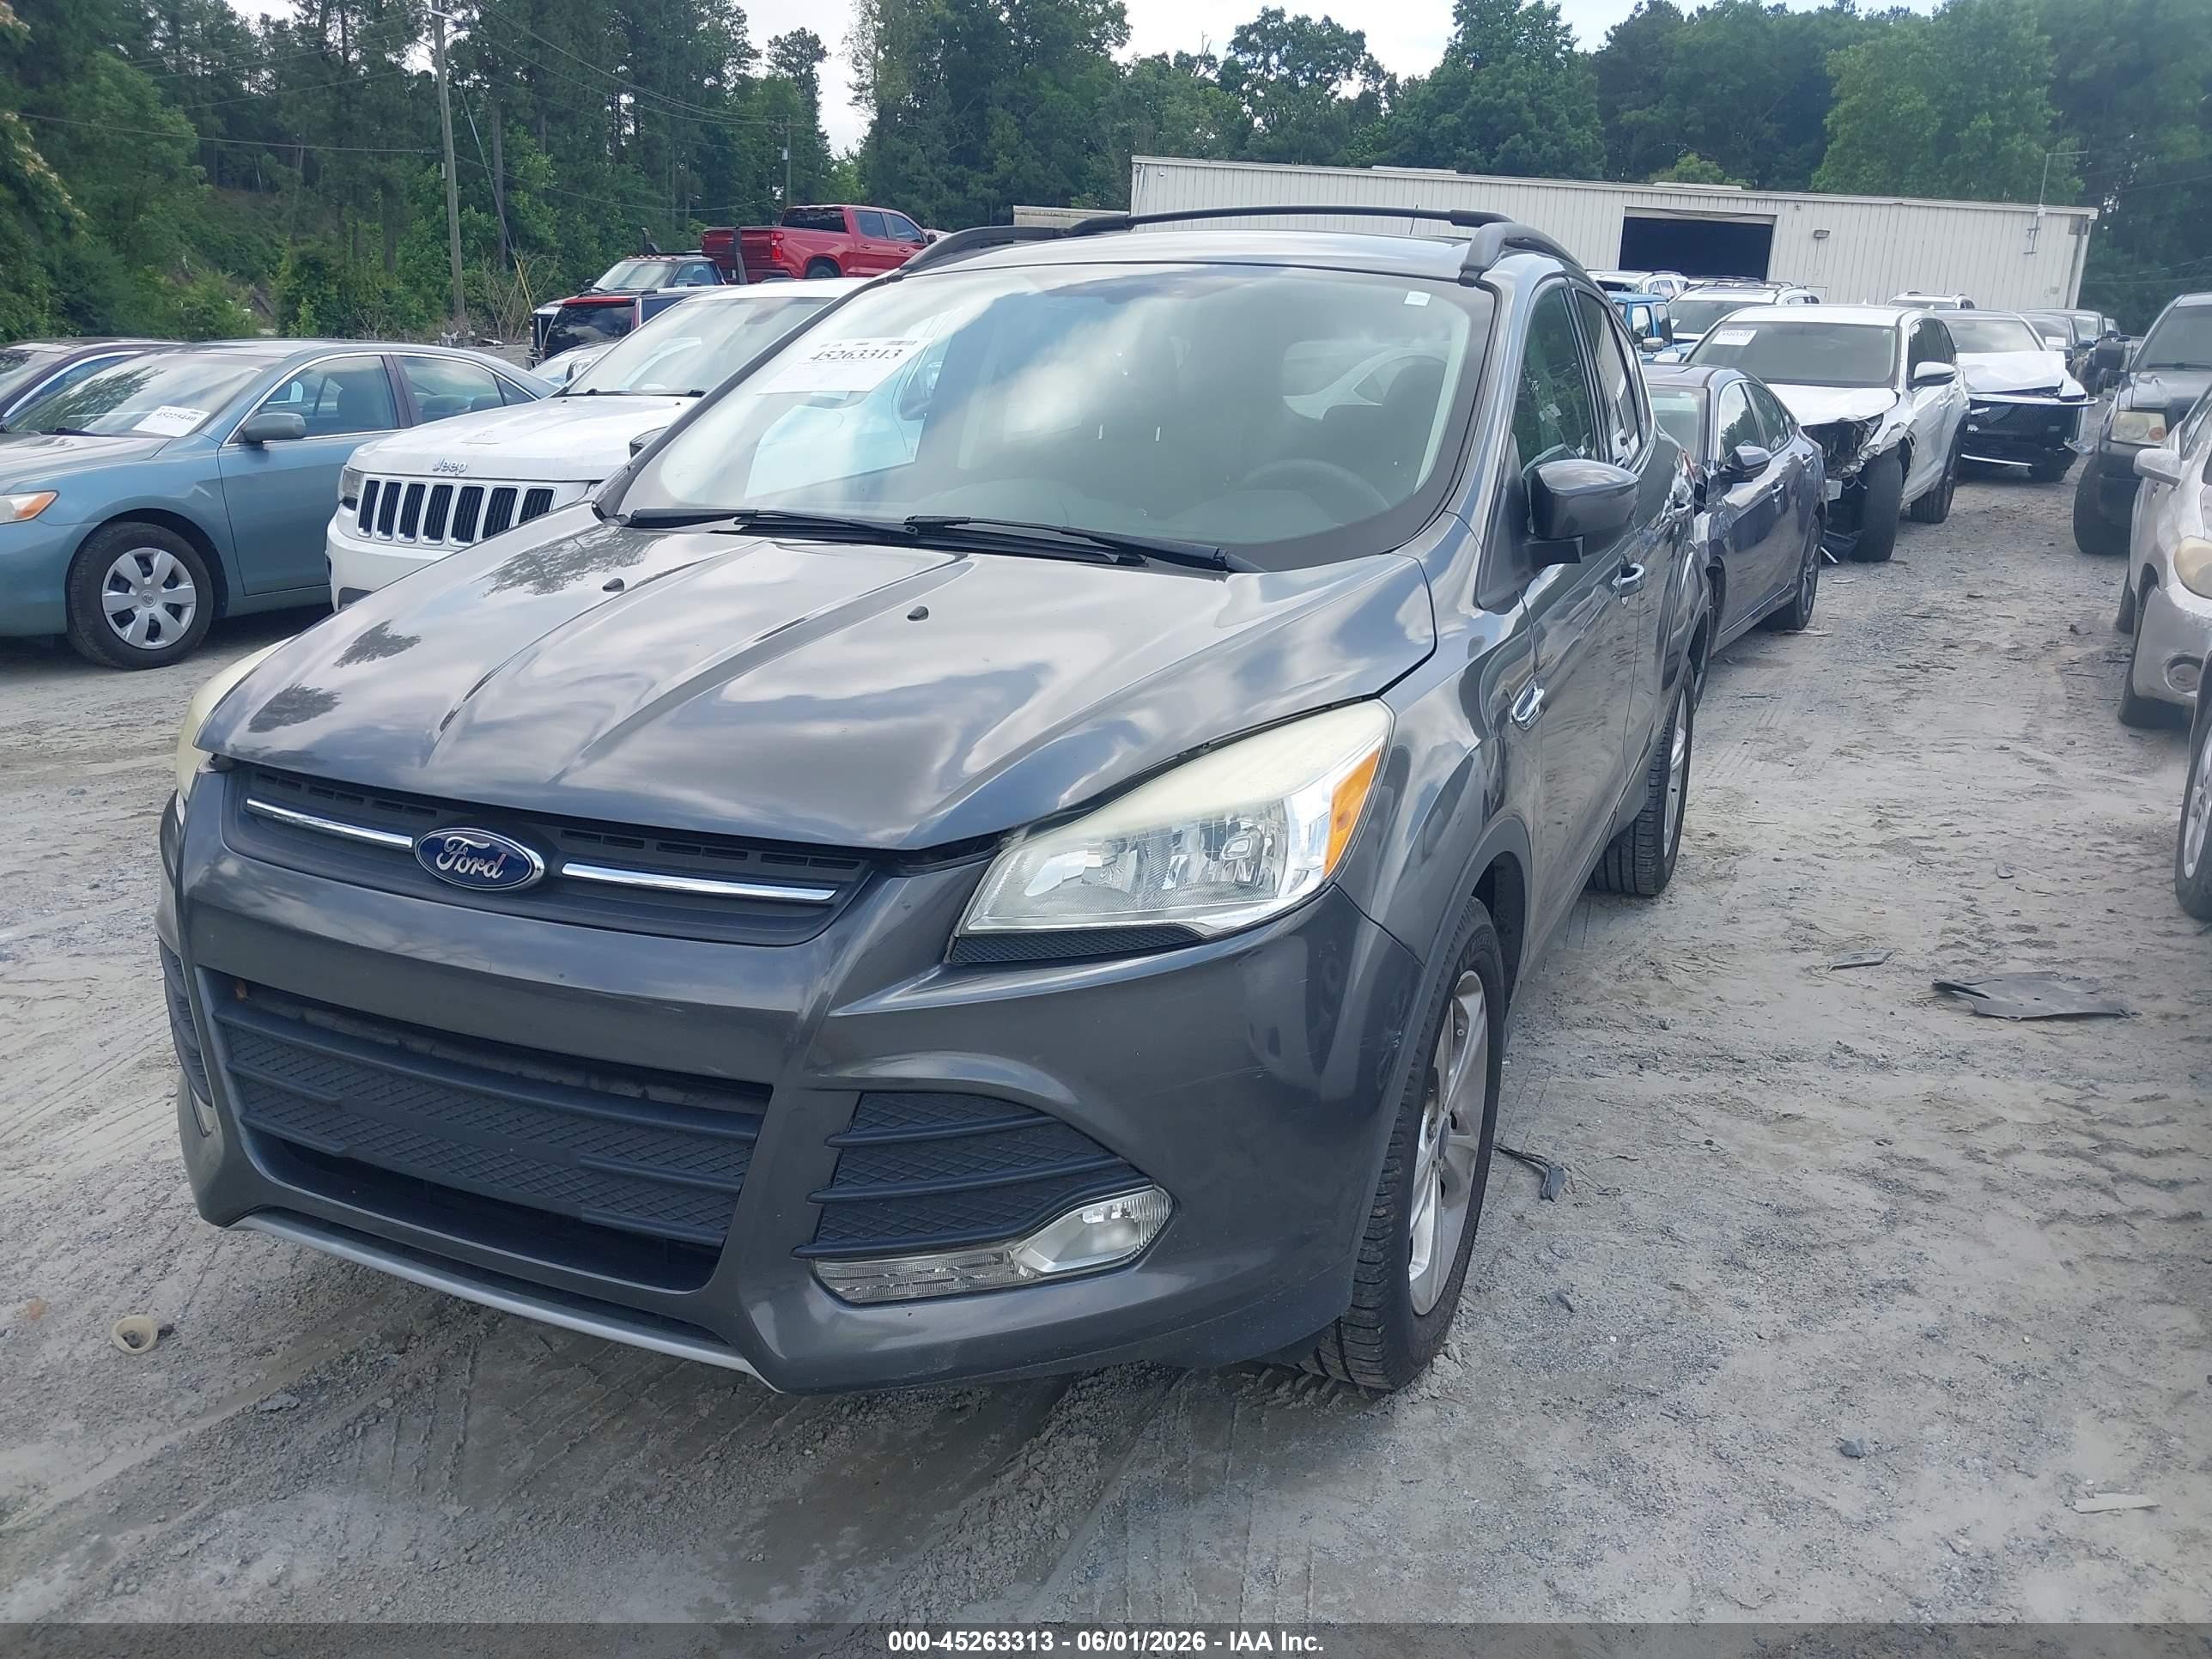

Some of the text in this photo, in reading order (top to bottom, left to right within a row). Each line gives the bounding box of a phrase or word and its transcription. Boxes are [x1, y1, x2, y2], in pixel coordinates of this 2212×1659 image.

[809, 349, 903, 361] 45263313
[432, 457, 468, 476] Jeep
[435, 836, 507, 879] Ford
